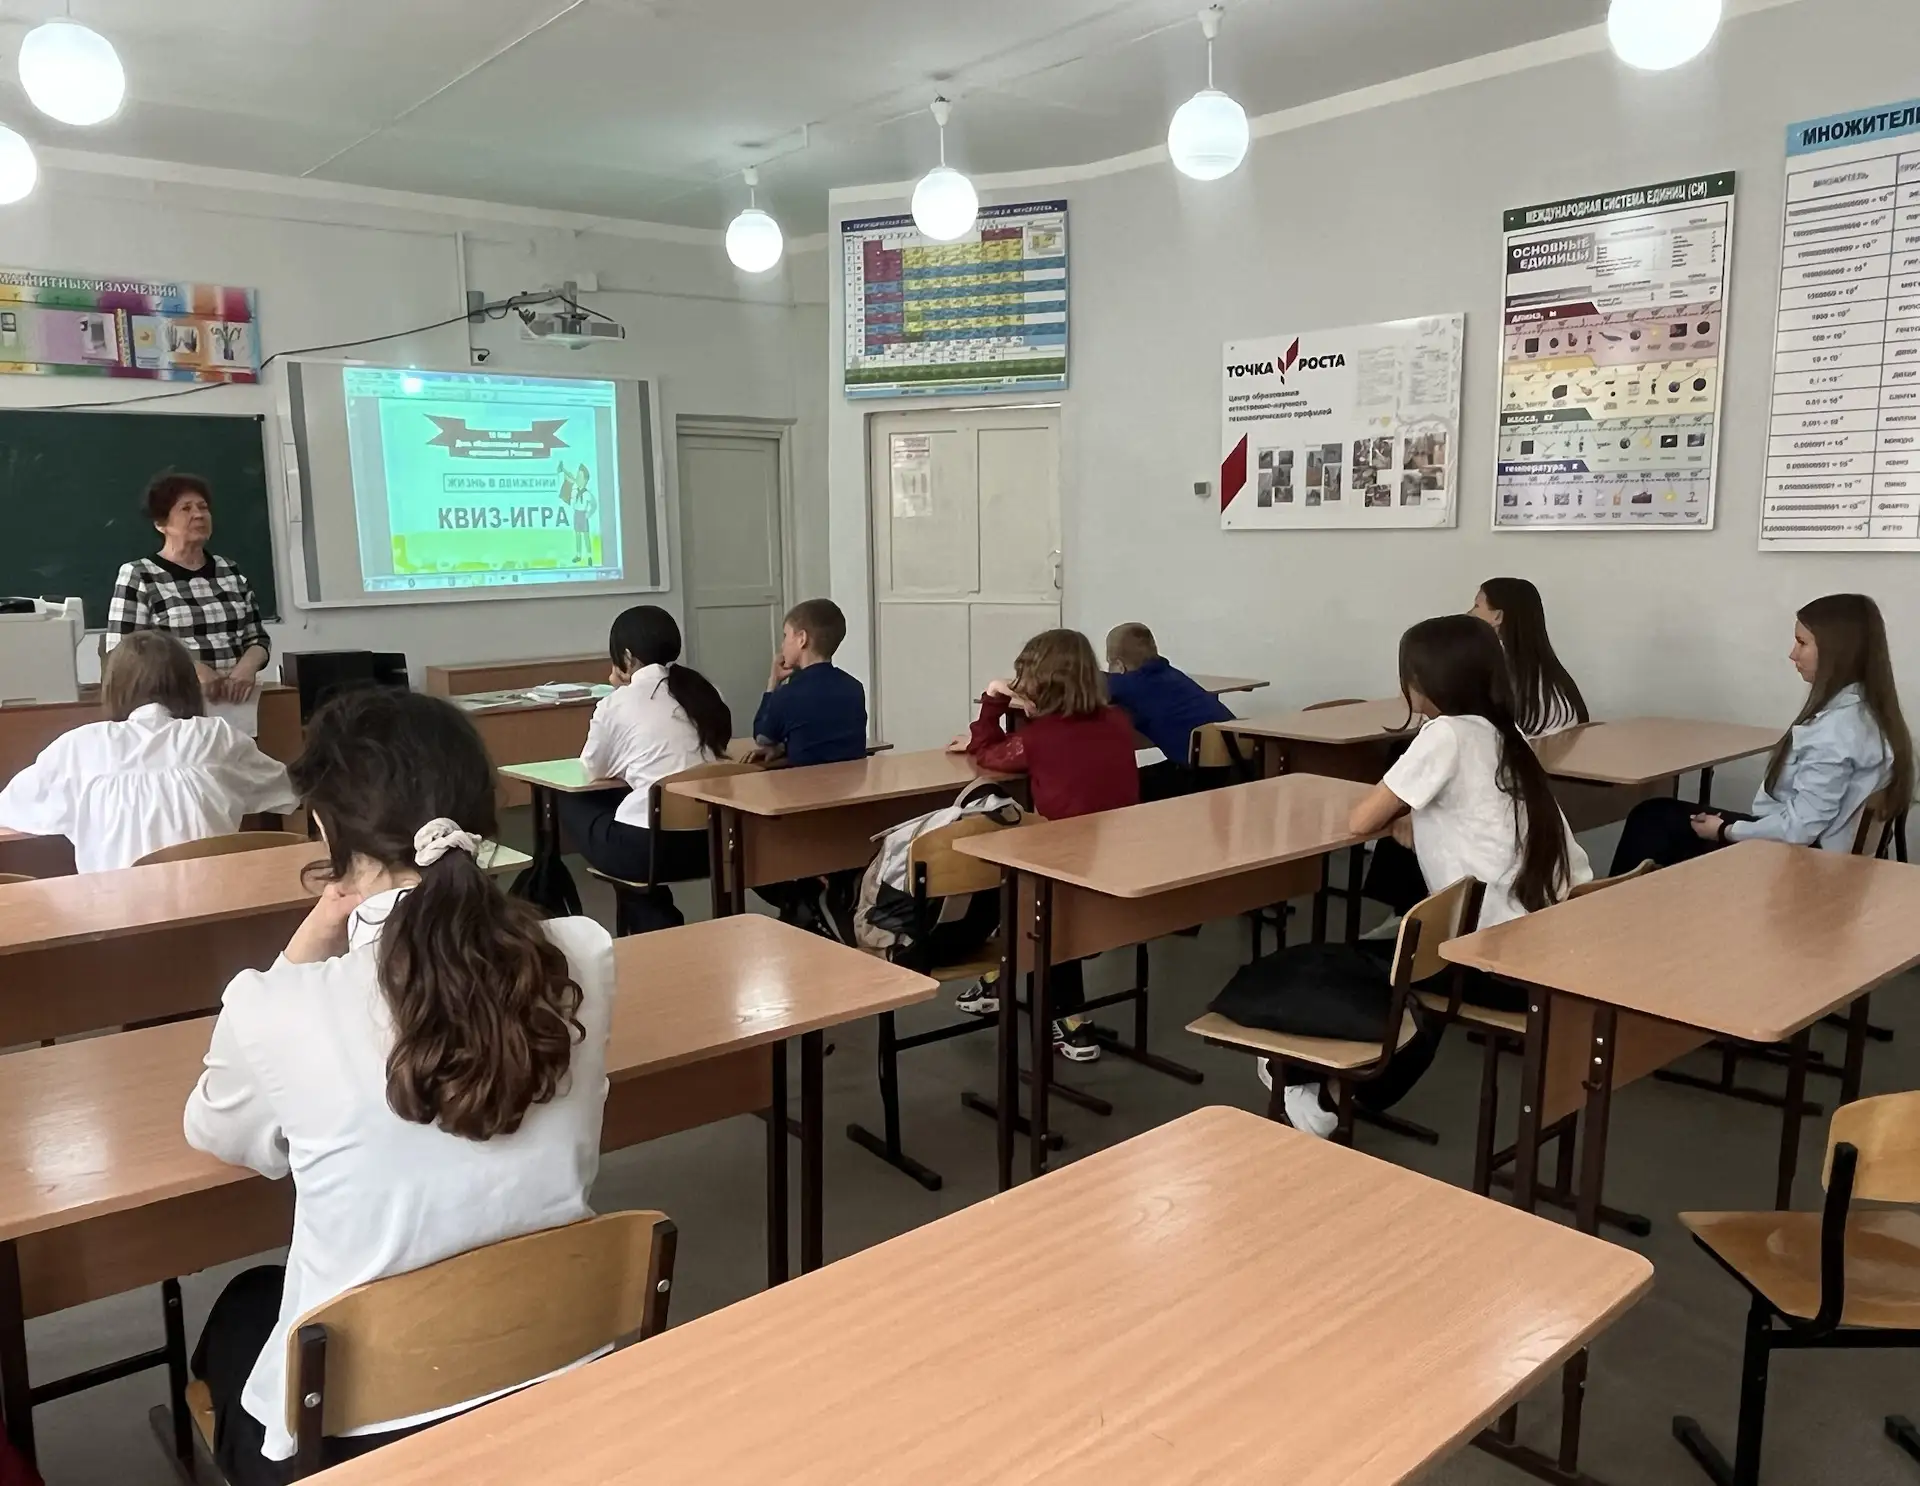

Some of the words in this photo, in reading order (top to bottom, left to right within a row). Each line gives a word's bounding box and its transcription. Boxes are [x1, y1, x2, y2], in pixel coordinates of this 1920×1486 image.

[1525, 201, 1602, 224] МЕЖДУНАРОДНАЯ
[1602, 193, 1646, 211] СИСТЕМА
[1646, 185, 1686, 204] ЕДИНИЦ
[1688, 181, 1708, 198] (СИ)
[1512, 237, 1590, 259] ОСНОВНЫЕ
[1520, 249, 1589, 270] ЕДИНИЦЫ
[1227, 362, 1274, 378] ТОЧКА
[1298, 353, 1346, 371] РОСТА
[447, 478, 486, 489] ЖИЗНЬ
[438, 506, 570, 530] КВИЗ-ИГРА
